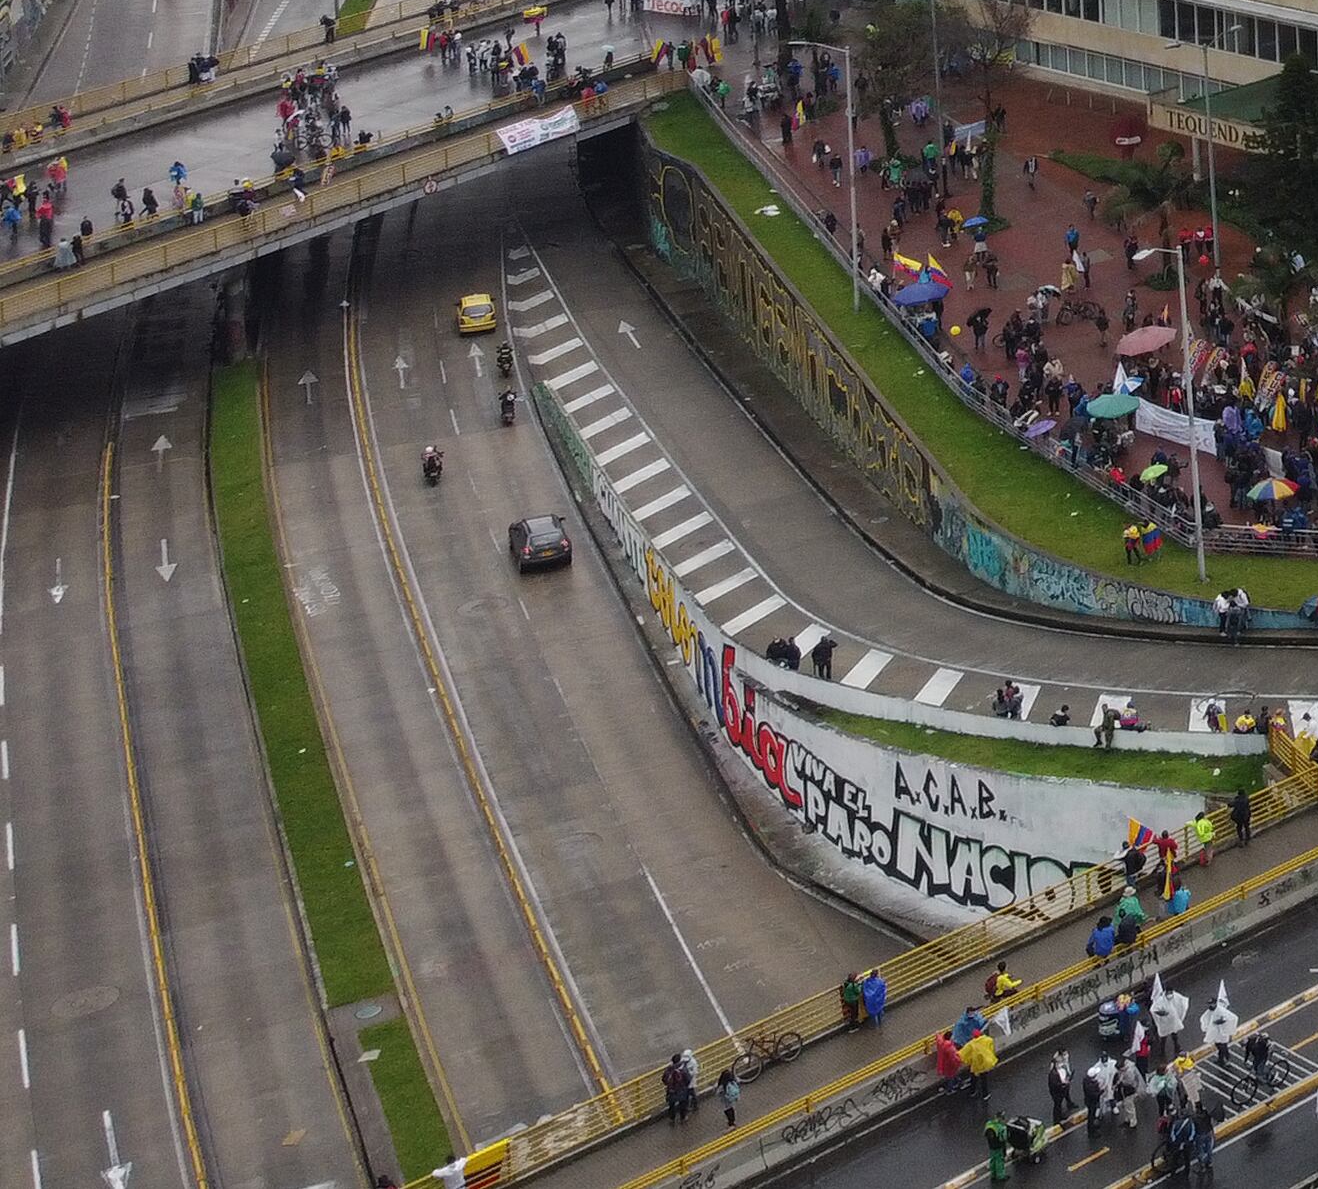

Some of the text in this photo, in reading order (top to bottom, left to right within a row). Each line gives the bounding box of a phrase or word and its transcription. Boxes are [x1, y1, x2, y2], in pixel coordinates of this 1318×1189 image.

[1166, 110, 1254, 146] TEQUEND
[787, 740, 868, 818] VIVA EL
[804, 778, 893, 866] PARO
